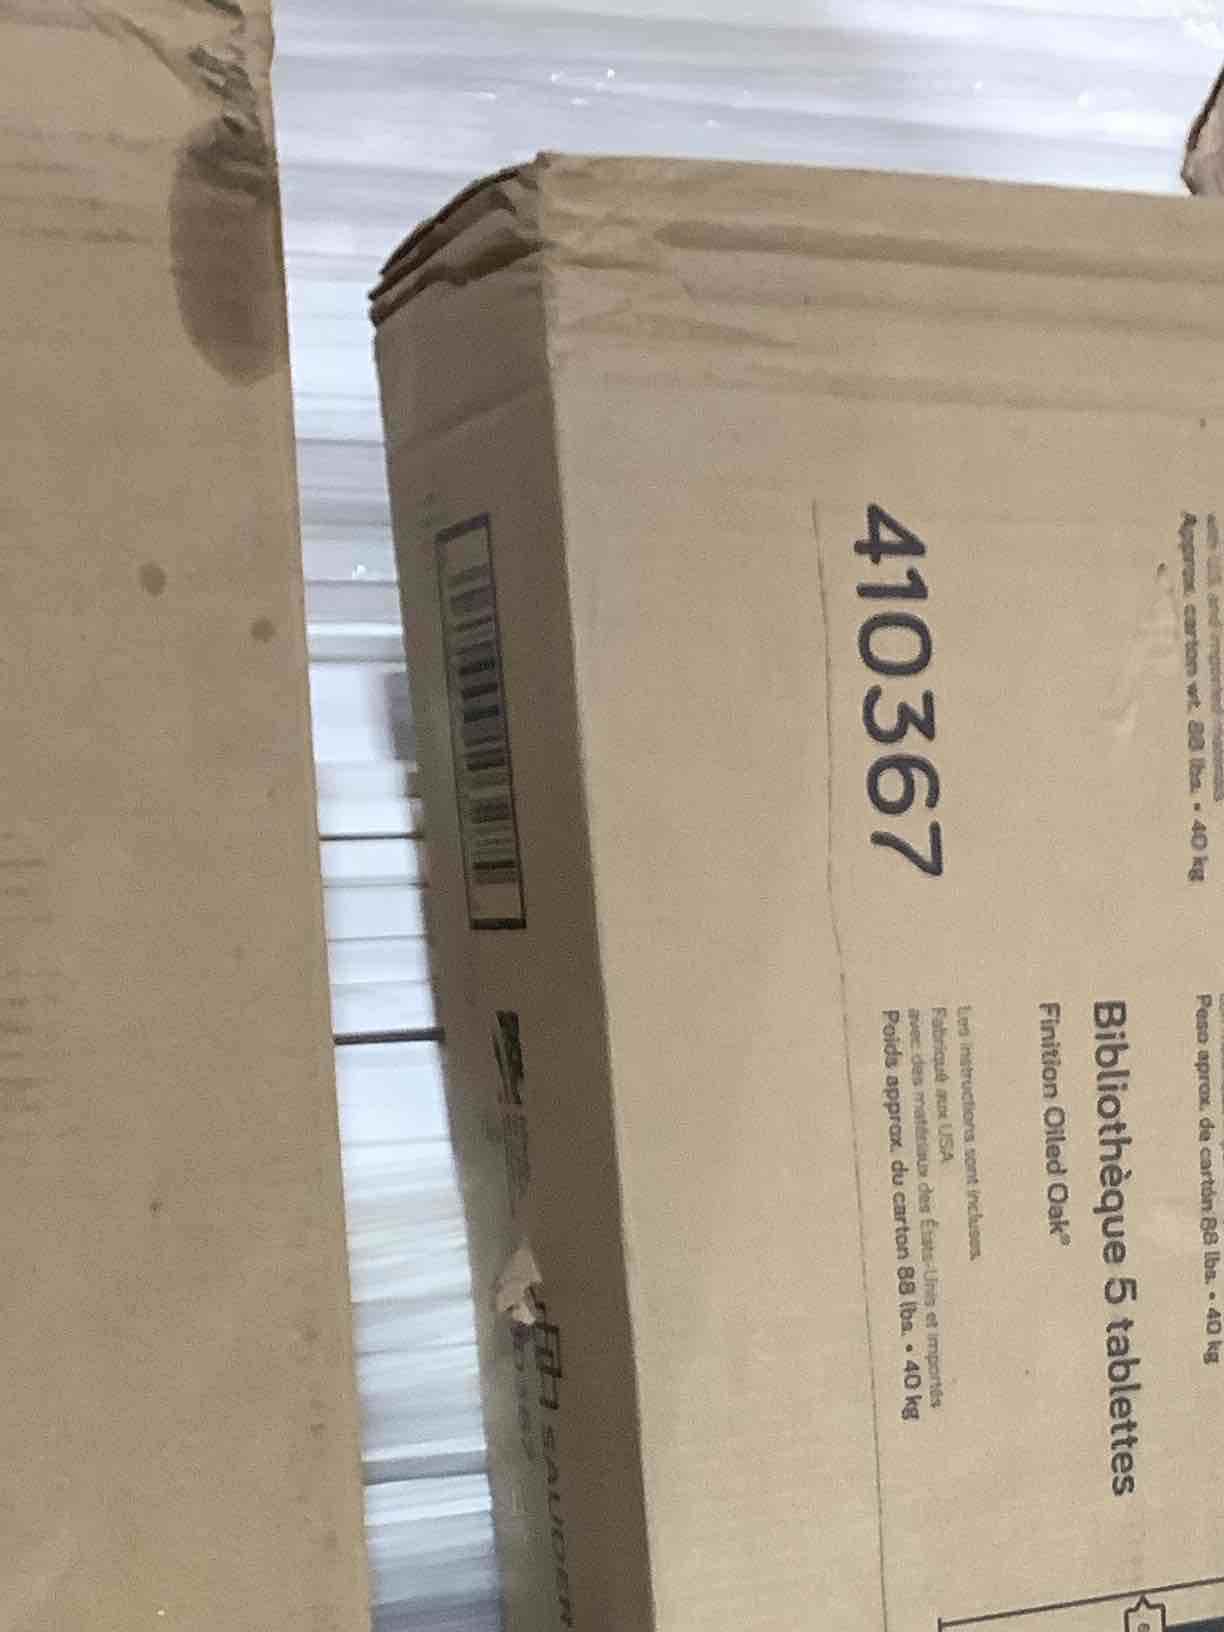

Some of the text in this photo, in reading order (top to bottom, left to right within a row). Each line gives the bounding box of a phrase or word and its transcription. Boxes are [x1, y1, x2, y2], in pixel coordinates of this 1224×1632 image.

[1182, 605, 1200, 677] carton
[852, 503, 943, 877] 410367
[1186, 720, 1204, 751] 88
[1189, 819, 1207, 850] 40
[1186, 856, 1207, 882] kg
[1194, 994, 1212, 1043] Peso
[881, 1009, 902, 1068] Poids
[1038, 1002, 1063, 1099] Finition
[957, 1043, 976, 1142] instructions
[936, 1124, 953, 1162] USA
[1042, 1107, 1067, 1174] Oiled
[1196, 1117, 1215, 1141] de
[889, 1159, 909, 1185] du
[962, 1149, 979, 1184] sont
[916, 1183, 934, 1213] des
[891, 1192, 911, 1260] carton
[1198, 1217, 1218, 1245] 88
[1091, 1001, 1141, 1497] Bibliothèque 5 tablettes
[896, 1266, 915, 1295] 88
[1202, 1251, 1220, 1285] lbs.
[898, 1302, 917, 1337] lbs.
[923, 1312, 939, 1328] et
[1204, 1307, 1222, 1335] 40
[1201, 1340, 1223, 1364] kg
[902, 1360, 921, 1390] 40
[899, 1395, 922, 1421] kg
